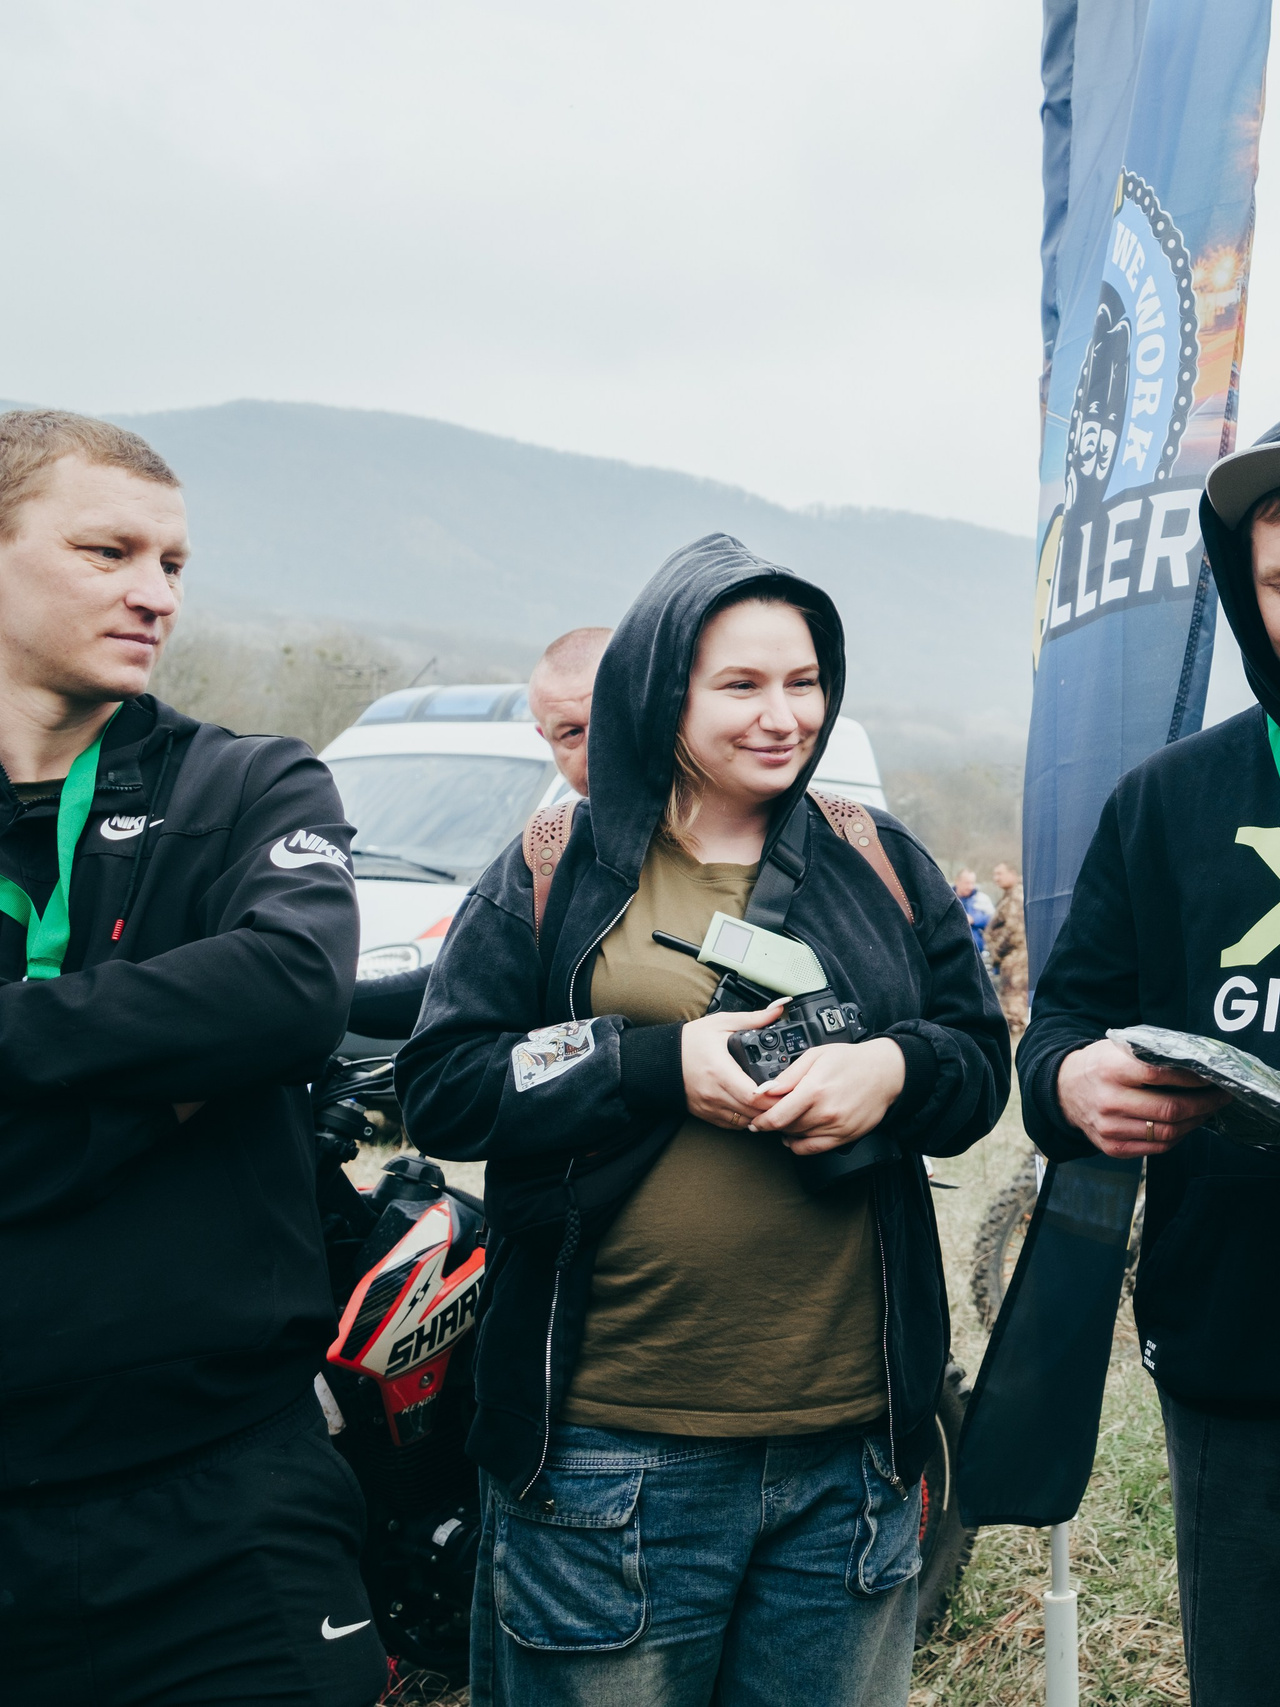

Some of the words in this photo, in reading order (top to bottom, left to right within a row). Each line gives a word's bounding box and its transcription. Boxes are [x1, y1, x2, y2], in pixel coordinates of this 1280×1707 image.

[1111, 221, 1146, 293] WE
[1121, 275, 1167, 472] WORK
[1041, 488, 1204, 637] LLER
[289, 829, 348, 863] NIKE
